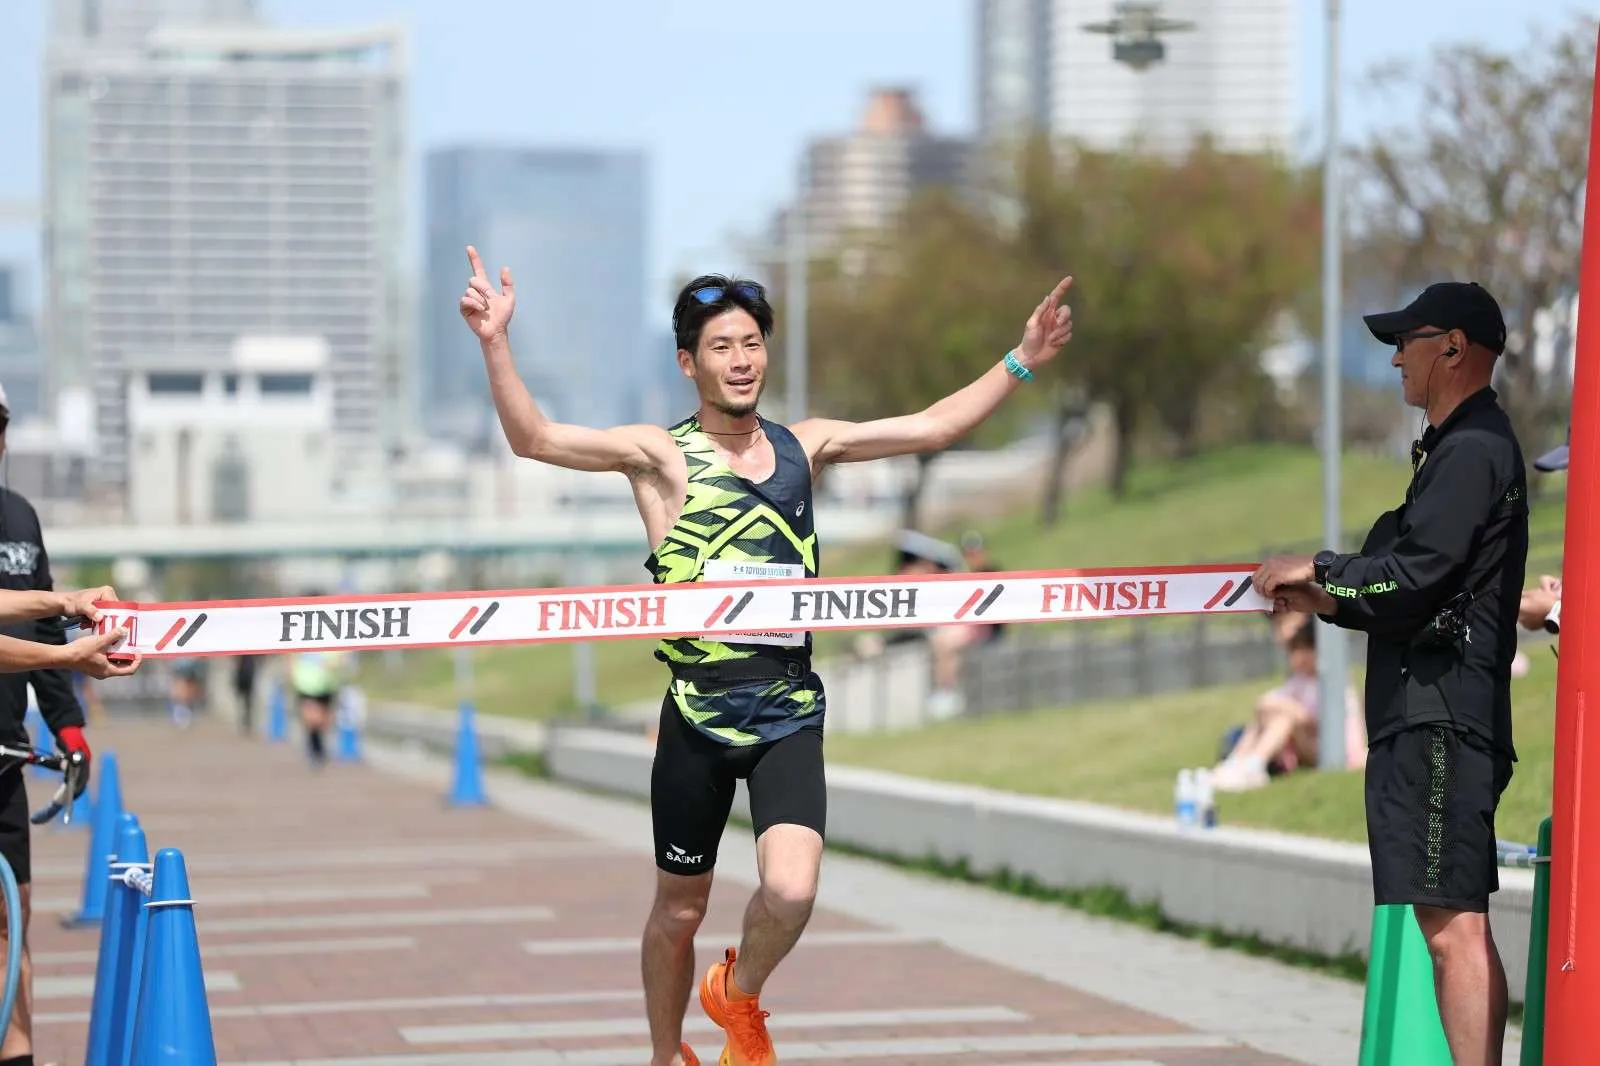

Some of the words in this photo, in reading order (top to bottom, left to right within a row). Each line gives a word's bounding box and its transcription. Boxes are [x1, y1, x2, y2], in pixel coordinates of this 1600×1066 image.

[1326, 582, 1357, 598] DER
[279, 606, 412, 642] FINISH
[537, 596, 668, 632] FINISH
[790, 588, 919, 621] FINISH
[1041, 580, 1169, 614] FINISH
